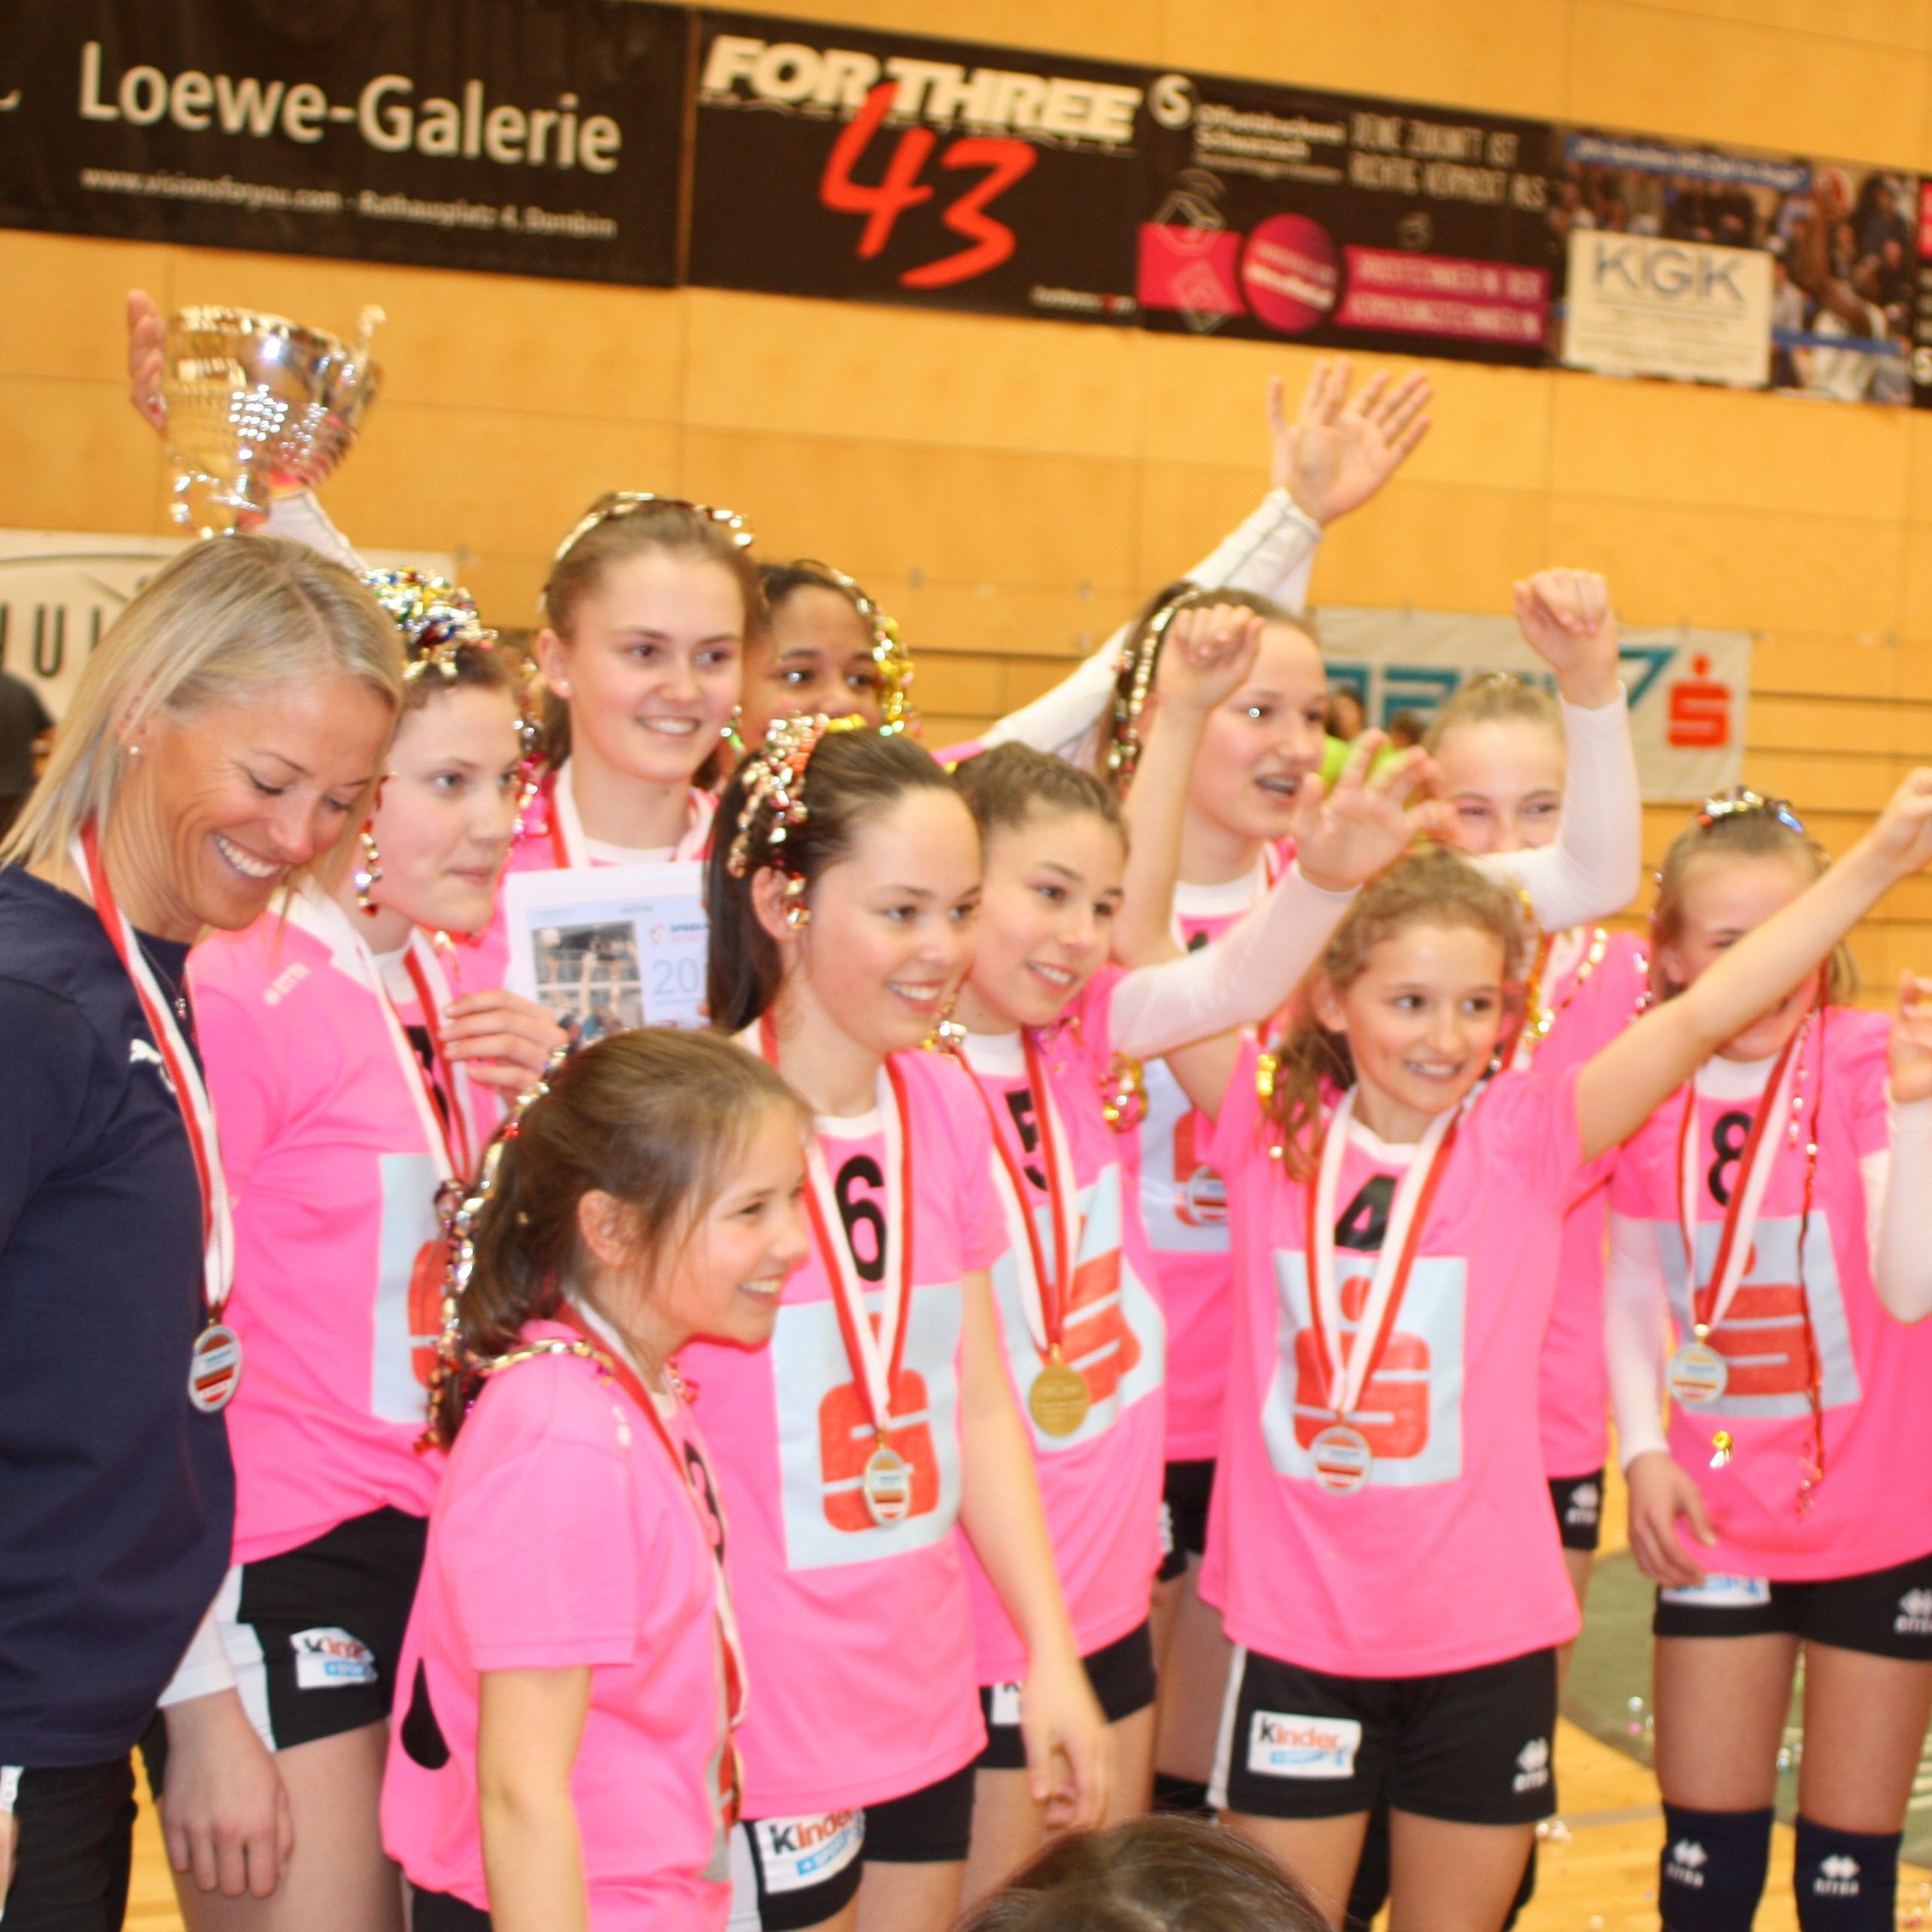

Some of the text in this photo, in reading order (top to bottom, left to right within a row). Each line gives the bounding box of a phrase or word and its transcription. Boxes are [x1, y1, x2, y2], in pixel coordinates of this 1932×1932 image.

[79, 41, 621, 173] Loewe-Galerie
[701, 34, 1143, 145] FOR THREE
[819, 80, 1038, 288] 43
[835, 1155, 887, 1282] 6
[1334, 1173, 1398, 1252] 4
